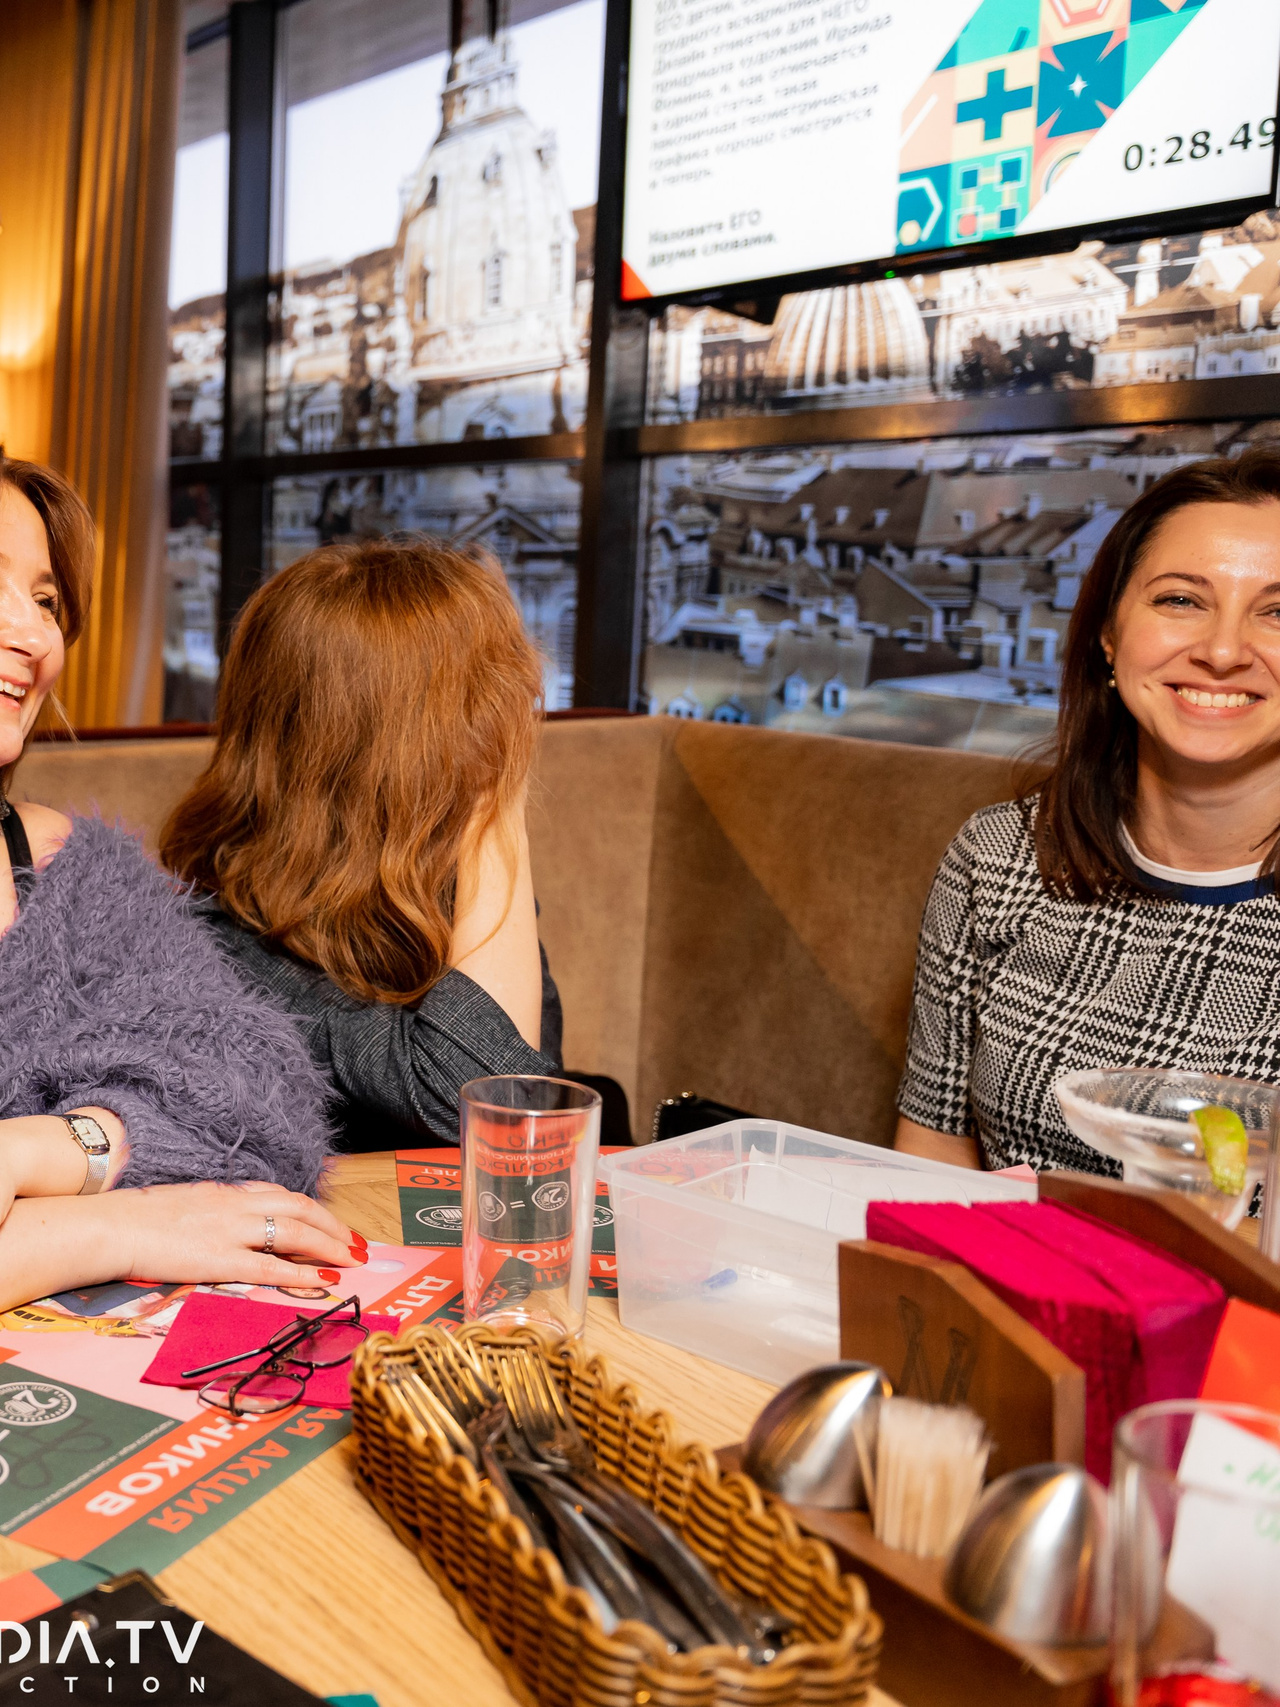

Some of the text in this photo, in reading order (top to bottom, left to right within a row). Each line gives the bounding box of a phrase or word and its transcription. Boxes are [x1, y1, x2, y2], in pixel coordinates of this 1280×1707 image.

[1123, 116, 1277, 171] 0:28.49
[385, 1275, 453, 1322] ДЛЯ
[146, 1439, 290, 1534] АКЦИЯ
